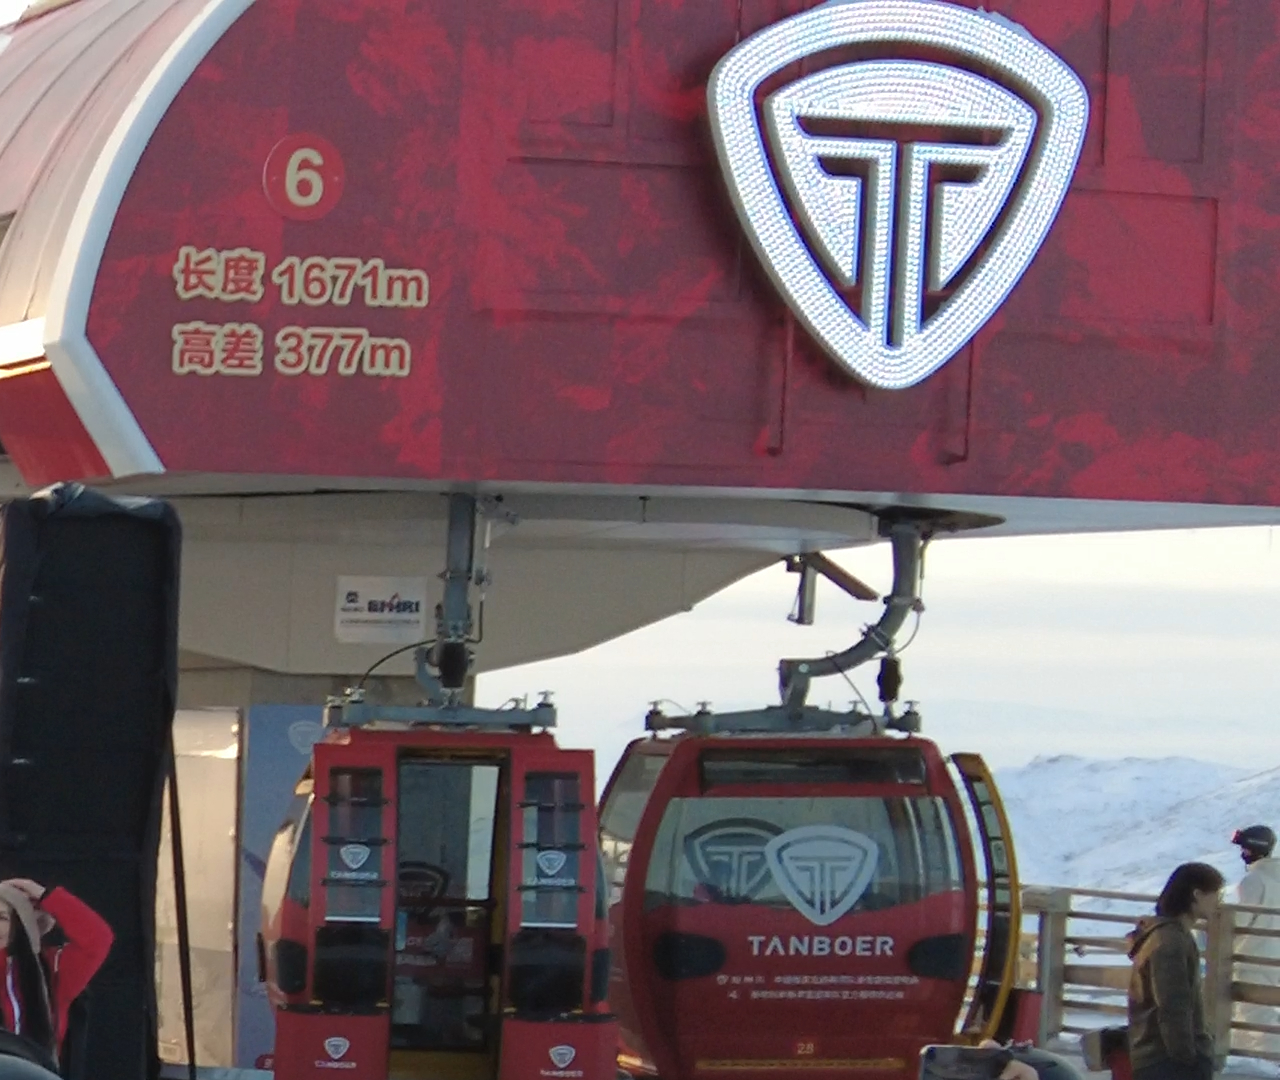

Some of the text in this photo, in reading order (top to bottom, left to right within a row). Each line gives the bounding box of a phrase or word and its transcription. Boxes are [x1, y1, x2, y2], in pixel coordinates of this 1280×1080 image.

[285, 148, 324, 207] 6
[173, 246, 429, 307] 长度 1671m
[172, 321, 411, 377] 高差 377m
[747, 935, 895, 957] TANBOER
